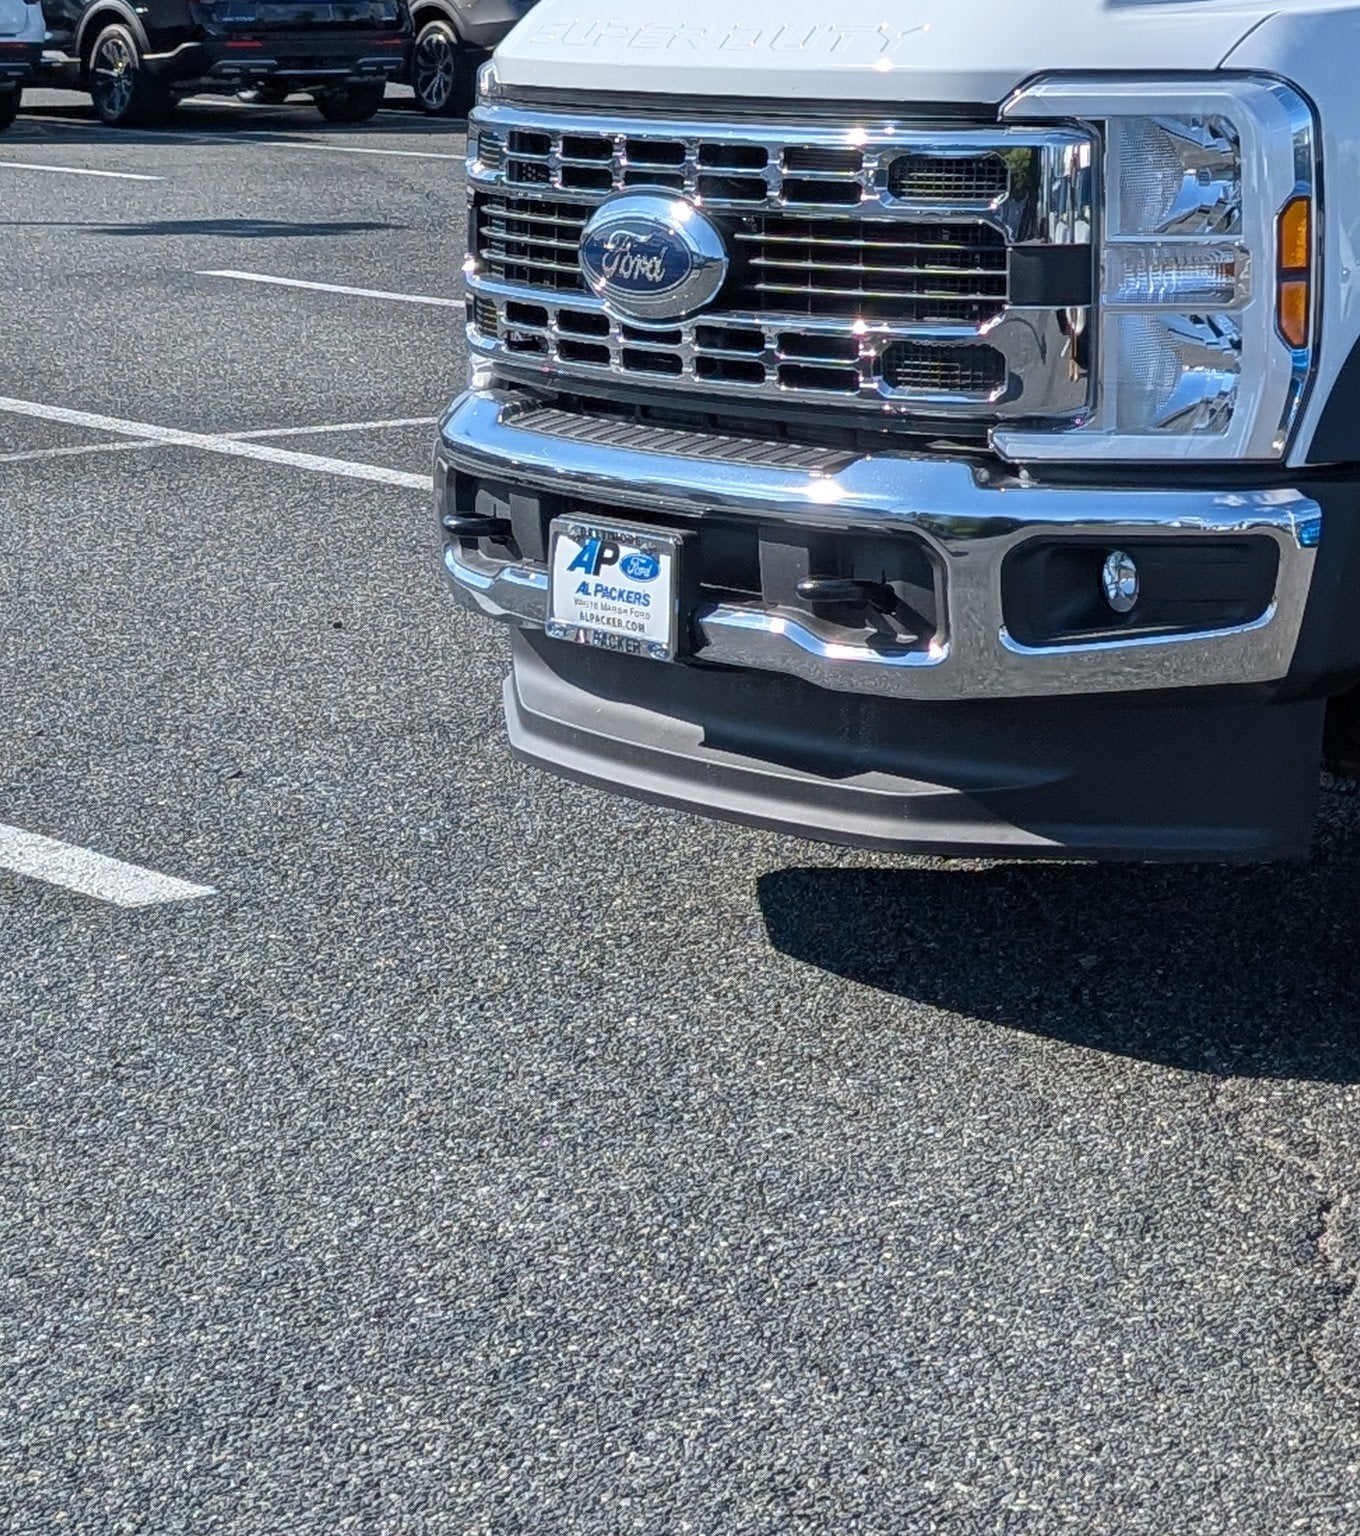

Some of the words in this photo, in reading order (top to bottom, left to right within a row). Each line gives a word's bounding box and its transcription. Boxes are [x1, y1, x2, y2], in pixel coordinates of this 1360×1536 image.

[529, 17, 707, 52] SUPER
[717, 19, 932, 54] DUTY
[601, 229, 670, 283] Ford
[566, 536, 620, 576] AP
[575, 580, 592, 597] AL
